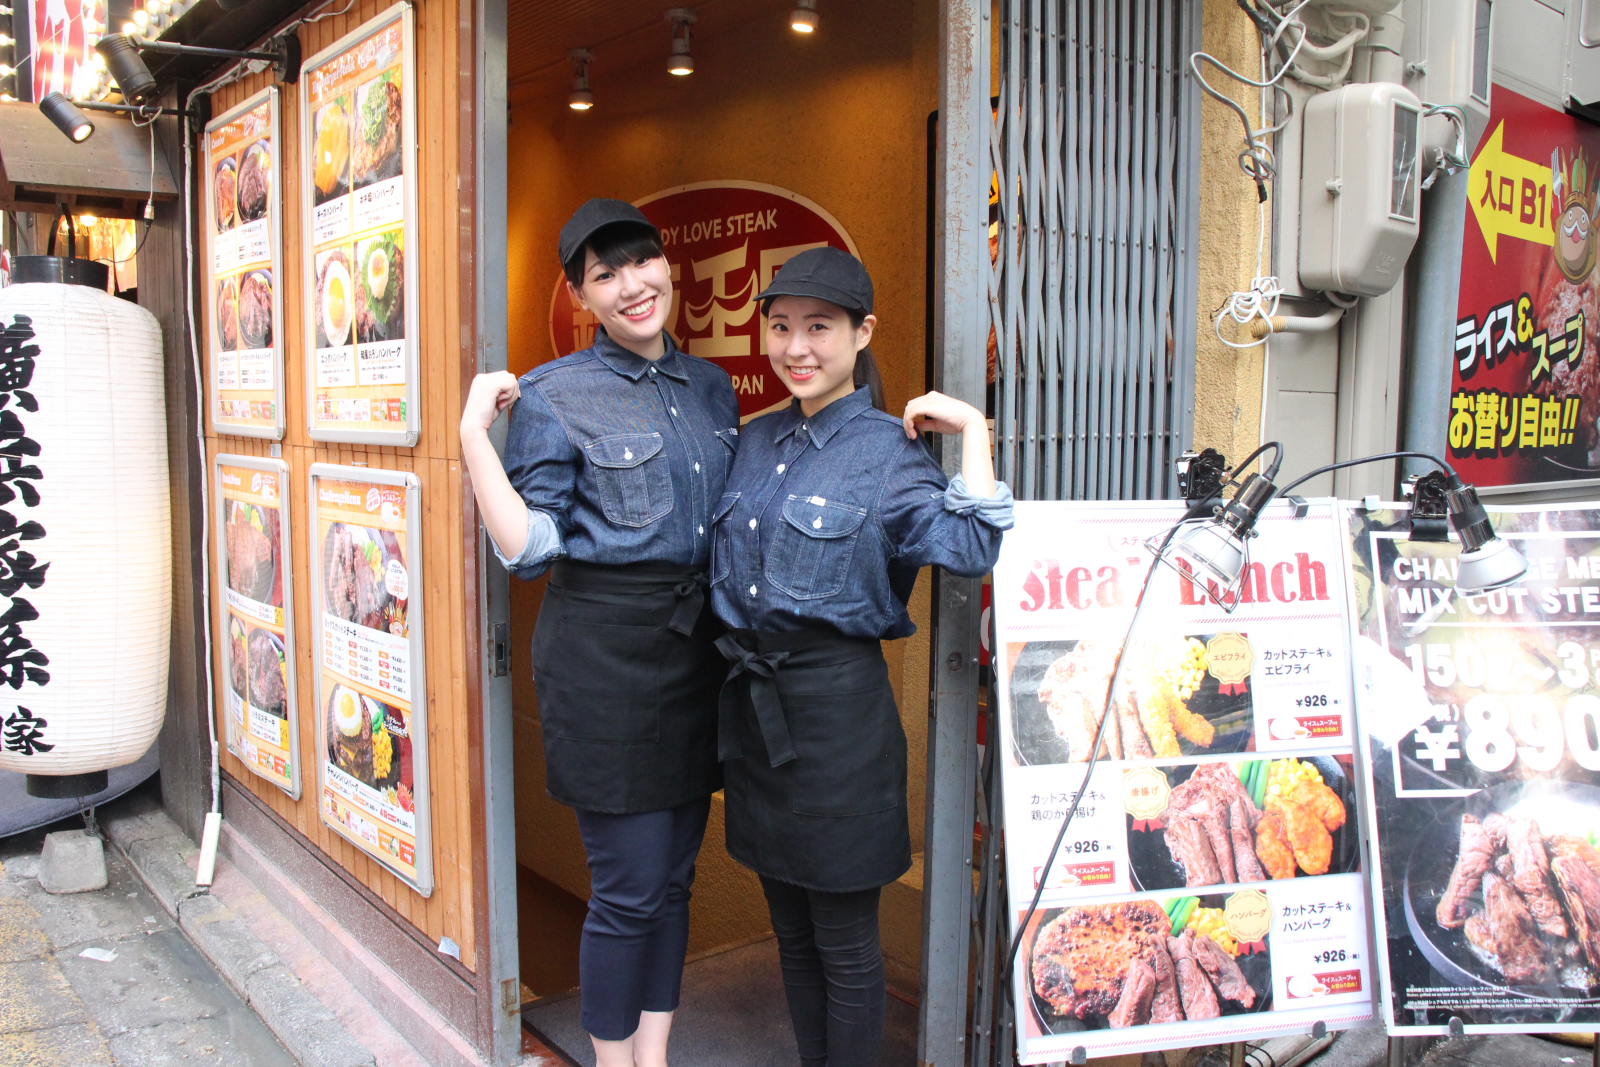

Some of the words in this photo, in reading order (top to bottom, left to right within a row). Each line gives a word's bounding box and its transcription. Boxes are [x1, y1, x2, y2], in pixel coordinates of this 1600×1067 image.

[1480, 170, 1514, 214] 入口
[1520, 177, 1546, 228] B1
[660, 226, 679, 246] DY
[683, 218, 722, 244] LOVE
[726, 208, 777, 236] STEAK
[732, 374, 764, 395] PAN
[1394, 557, 1558, 580] CHAGE
[1398, 588, 1457, 614] MIX
[1466, 587, 1528, 614] CUT
[1214, 652, 1246, 661] エビフライ
[1264, 648, 1332, 661] カットステーキ&
[1264, 663, 1311, 676] エビフライ
[1296, 695, 1327, 707] ¥926
[1131, 785, 1159, 797] 唐揚げ
[1065, 840, 1100, 854] ¥926
[1230, 908, 1267, 919] ハンバーグ
[1282, 901, 1352, 917] カットステーキ&
[1283, 917, 1332, 932] ハンバーグ
[1314, 950, 1346, 963] ¥926
